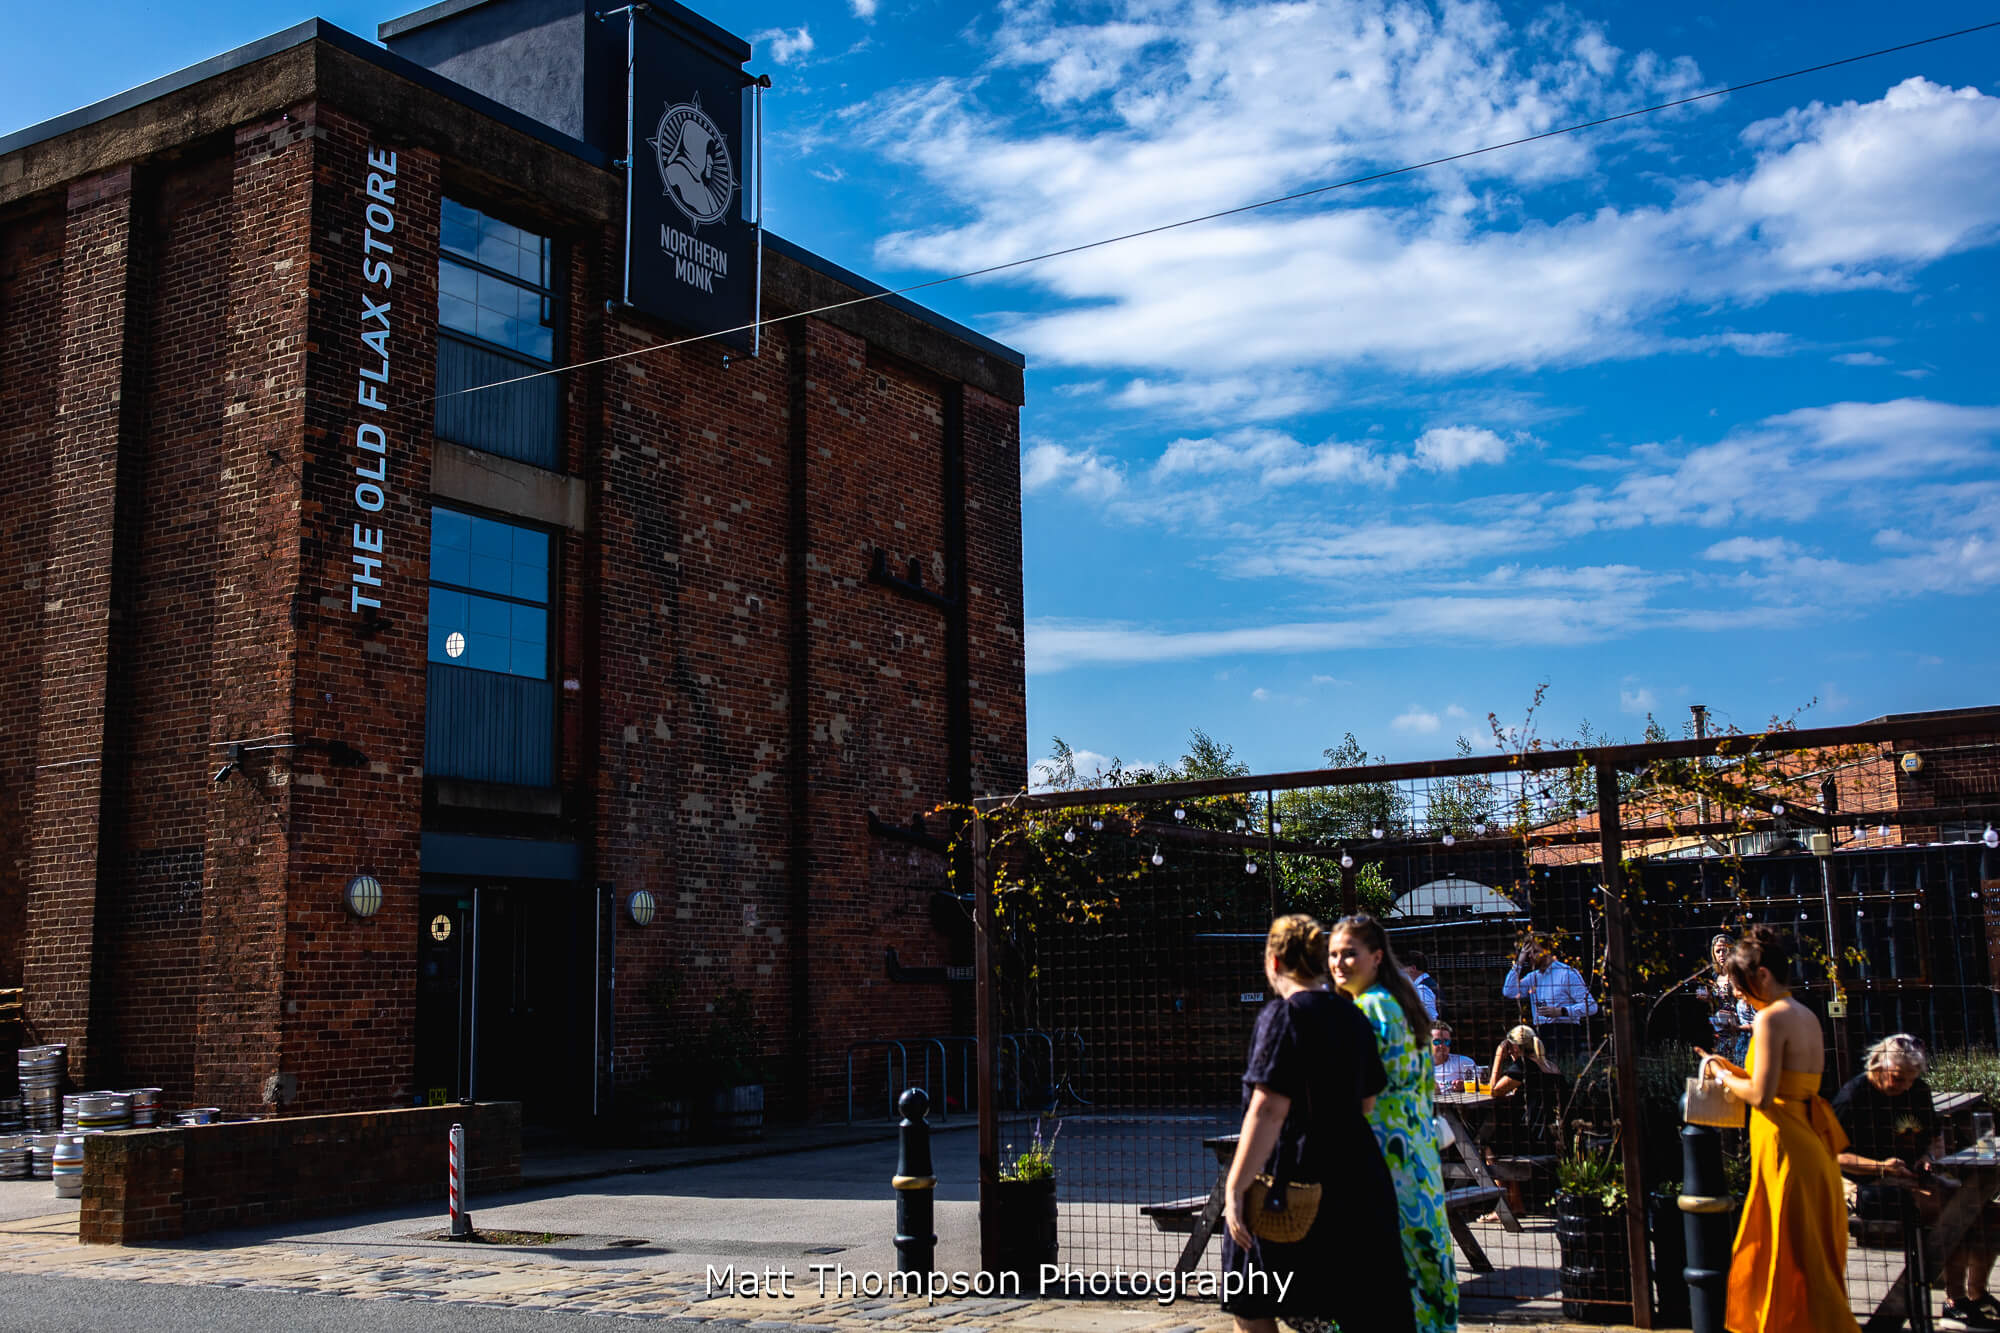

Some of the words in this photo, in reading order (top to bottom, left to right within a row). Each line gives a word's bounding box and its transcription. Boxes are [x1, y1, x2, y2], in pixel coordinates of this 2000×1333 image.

[363, 144, 398, 289] STORE
[660, 223, 728, 276] NORTHERN
[675, 255, 713, 294] MONK
[358, 293, 391, 412] FLAX
[355, 423, 386, 512] OLD
[351, 523, 383, 613] THE
